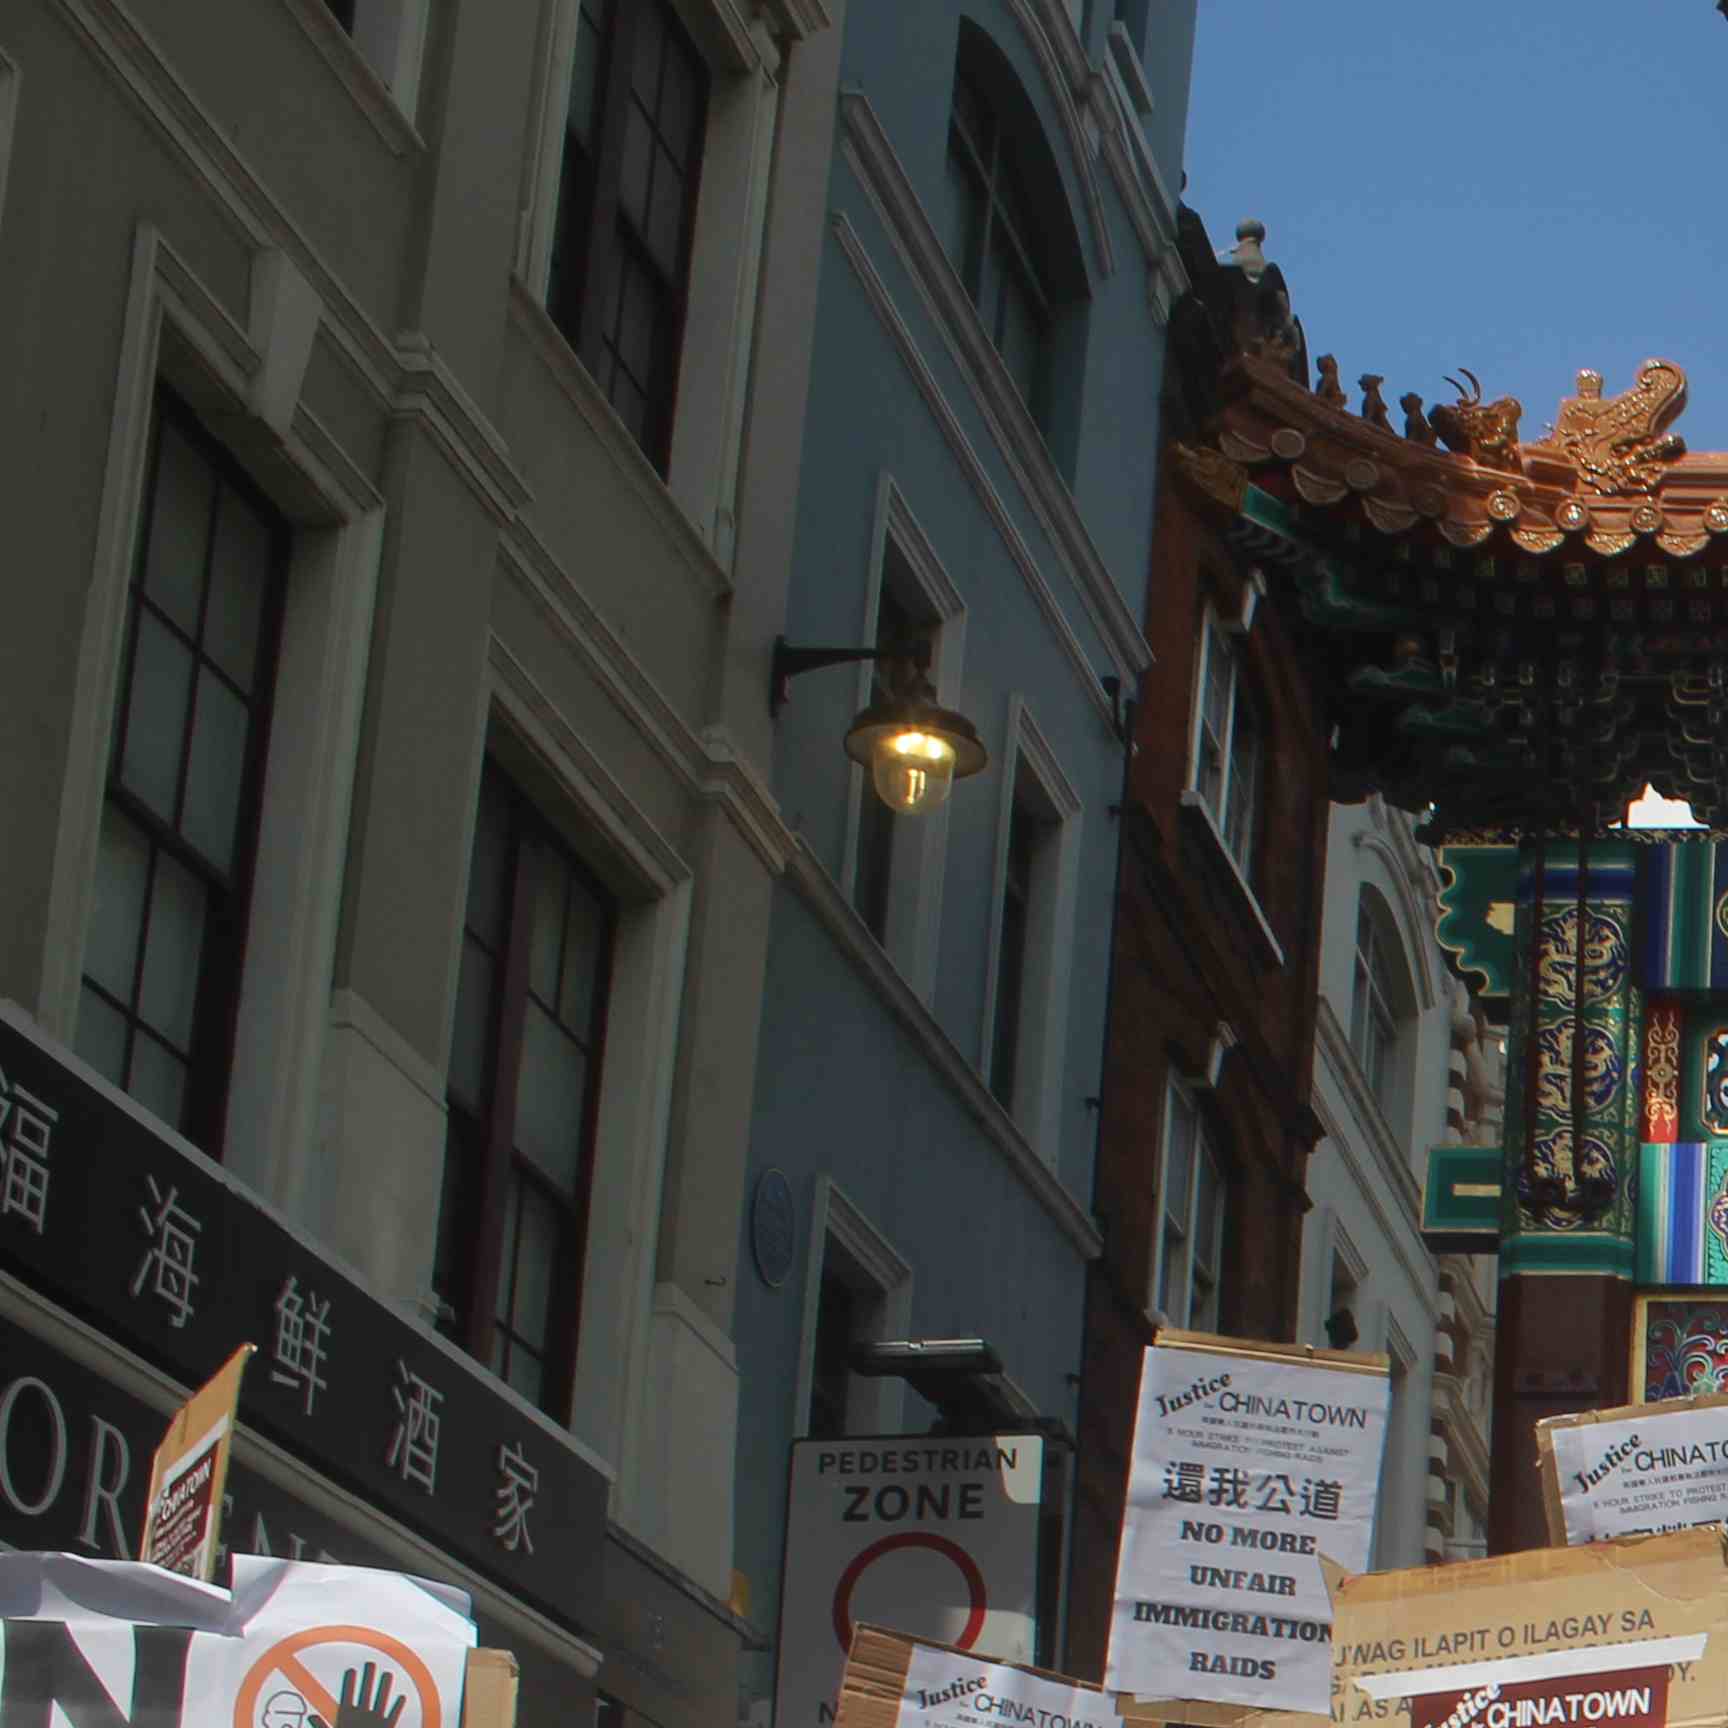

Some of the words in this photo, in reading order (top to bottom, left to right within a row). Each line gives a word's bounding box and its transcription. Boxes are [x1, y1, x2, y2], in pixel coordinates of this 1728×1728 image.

[1155, 1373, 1232, 1417] Justice
[1219, 1391, 1368, 1429] CHINATOWN
[819, 1448, 1017, 1475] PEDESTRIAN
[1573, 1433, 1642, 1494] Justice
[842, 1483, 985, 1522] ZONE
[1162, 1461, 1343, 1520] 還我公道
[1181, 1521, 1224, 1545] NO
[1232, 1525, 1316, 1556] MORE
[1190, 1565, 1296, 1598] UNFAIR
[1134, 1602, 1332, 1644] IMMIGRATION
[1412, 1630, 1490, 1659] ILAPIT
[1497, 1625, 1516, 1646] O
[1523, 1615, 1614, 1644] ILAGAY
[1621, 1608, 1655, 1633] SA
[1189, 1652, 1275, 1680] RAIDS
[918, 1677, 988, 1710] Justice
